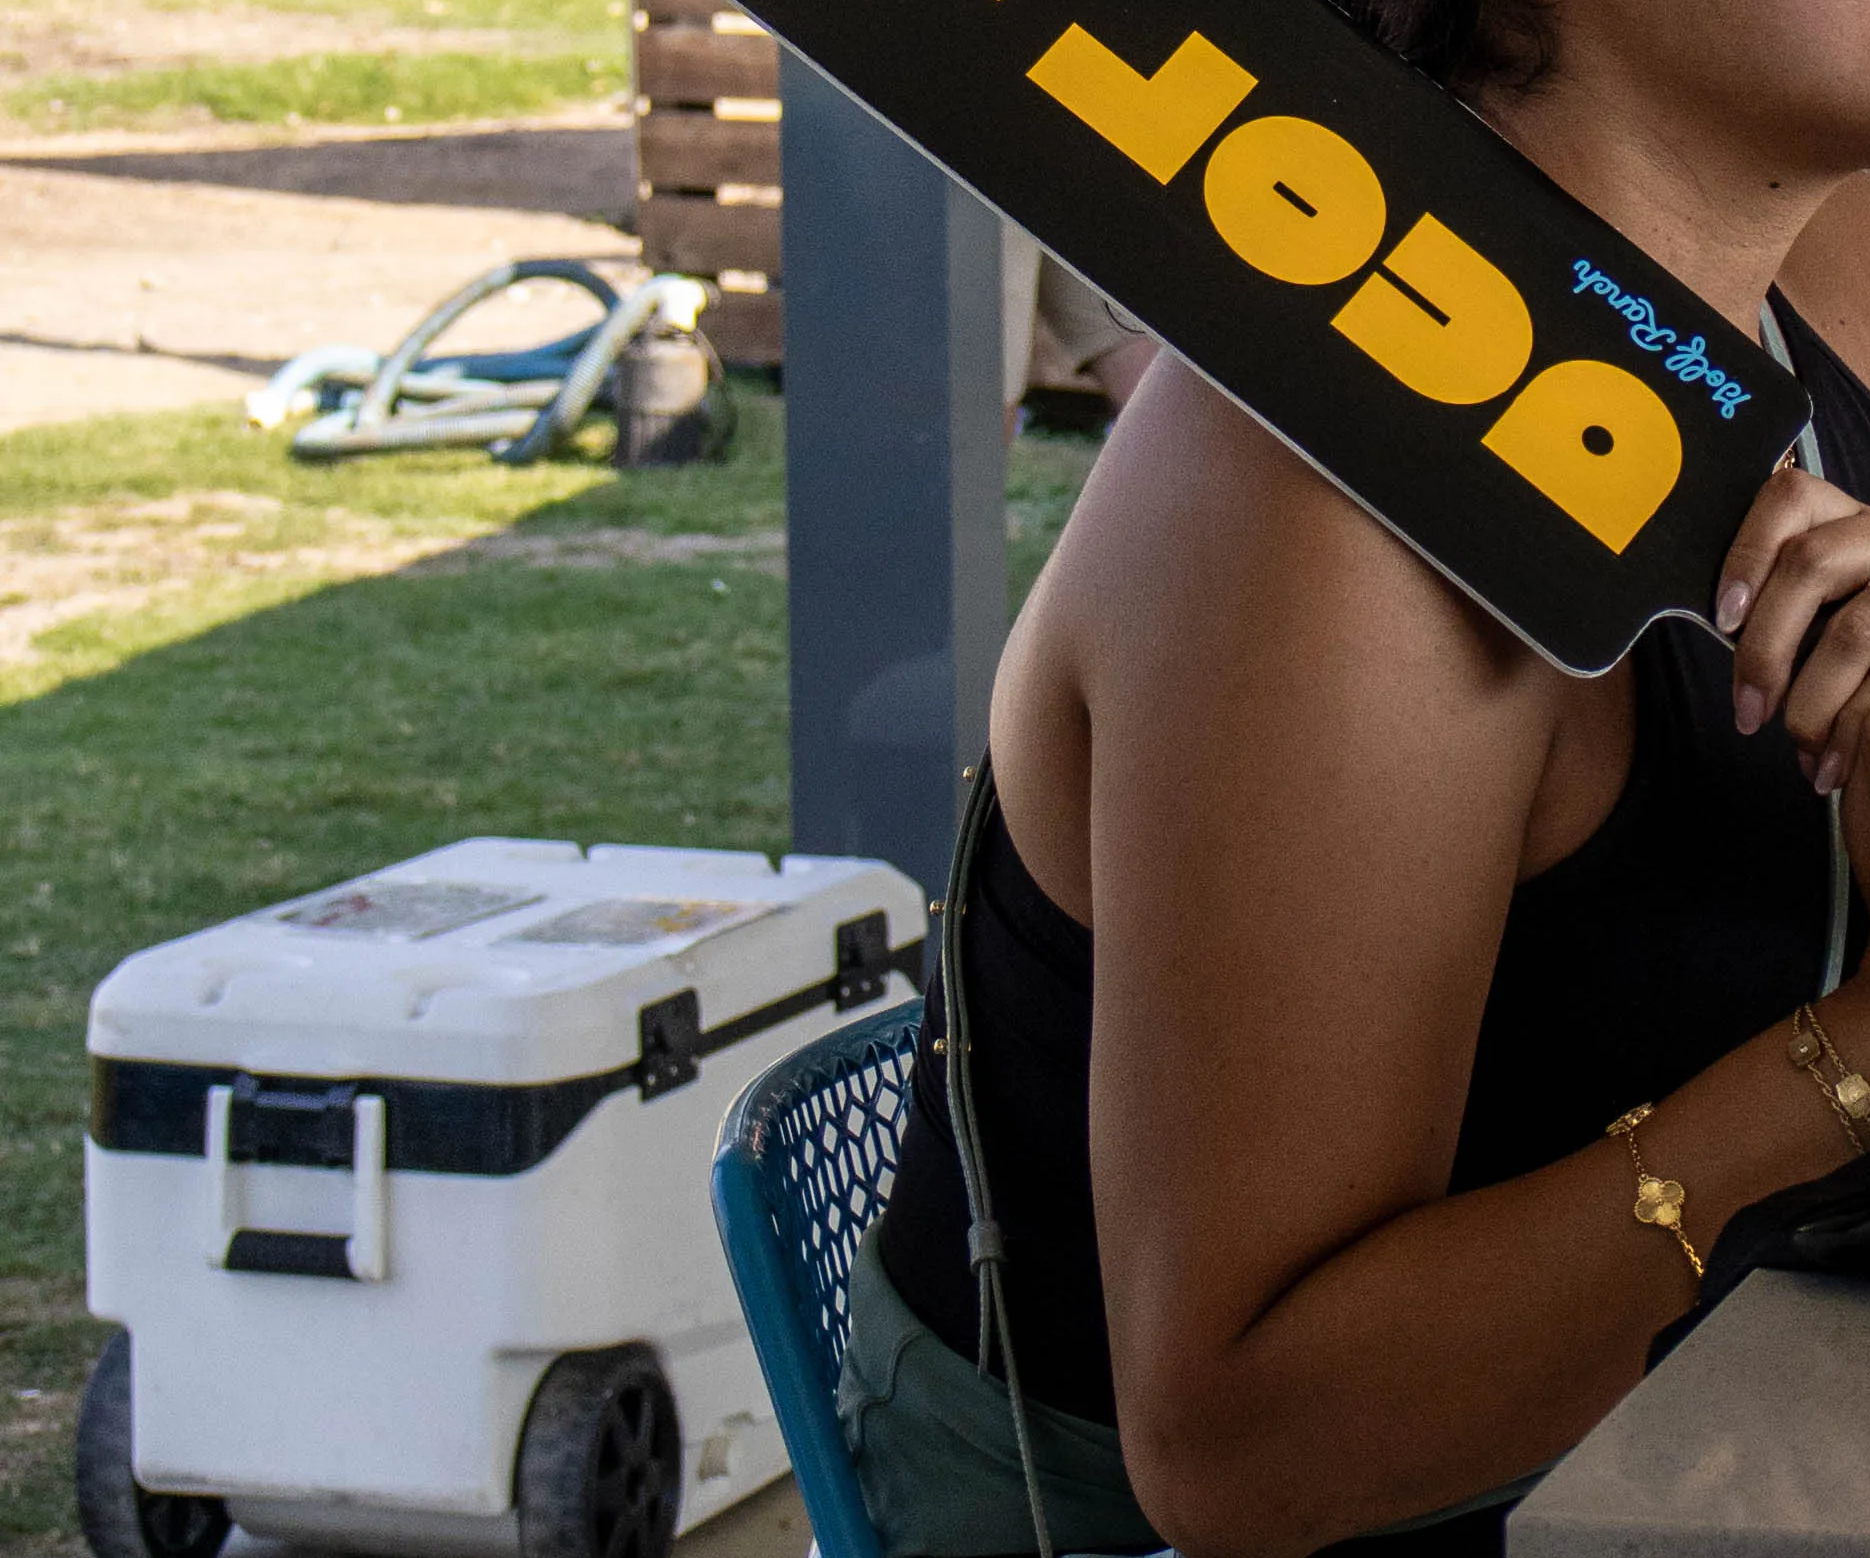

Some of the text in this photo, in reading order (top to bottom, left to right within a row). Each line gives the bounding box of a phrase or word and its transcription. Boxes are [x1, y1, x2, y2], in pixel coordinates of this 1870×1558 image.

[1026, 23, 1682, 554] LOUD
[1572, 259, 1751, 419] Golf Ranch
